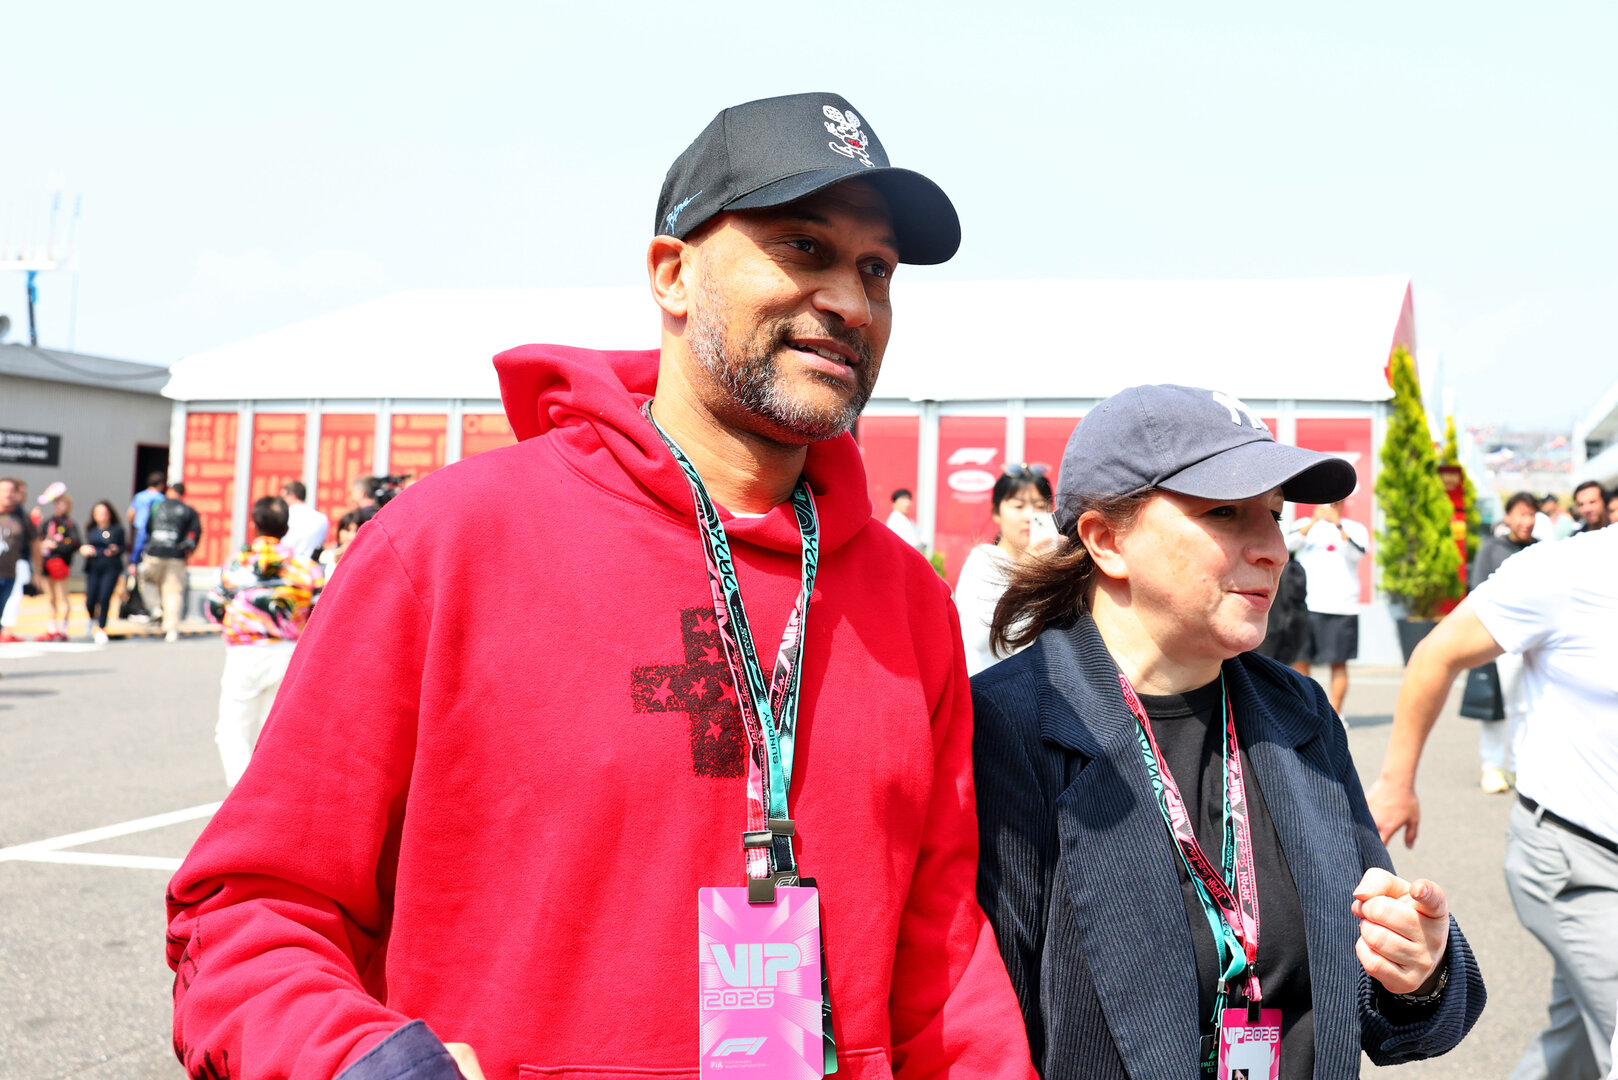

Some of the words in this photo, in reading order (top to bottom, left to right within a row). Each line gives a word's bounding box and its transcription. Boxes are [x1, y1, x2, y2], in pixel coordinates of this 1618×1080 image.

[710, 580, 729, 627] VIP
[744, 707, 759, 744] JAPAN
[763, 711, 779, 764] SUNDAY
[1236, 825, 1248, 868] Suzuka
[1206, 876, 1227, 899] JAPAN
[1241, 871, 1251, 905] JAPAN
[709, 943, 802, 988] VIP
[704, 989, 775, 1009] 2026
[1223, 1026, 1244, 1045] VIP
[1244, 1026, 1280, 1043] 2026
[710, 1061, 724, 1069] FIA
